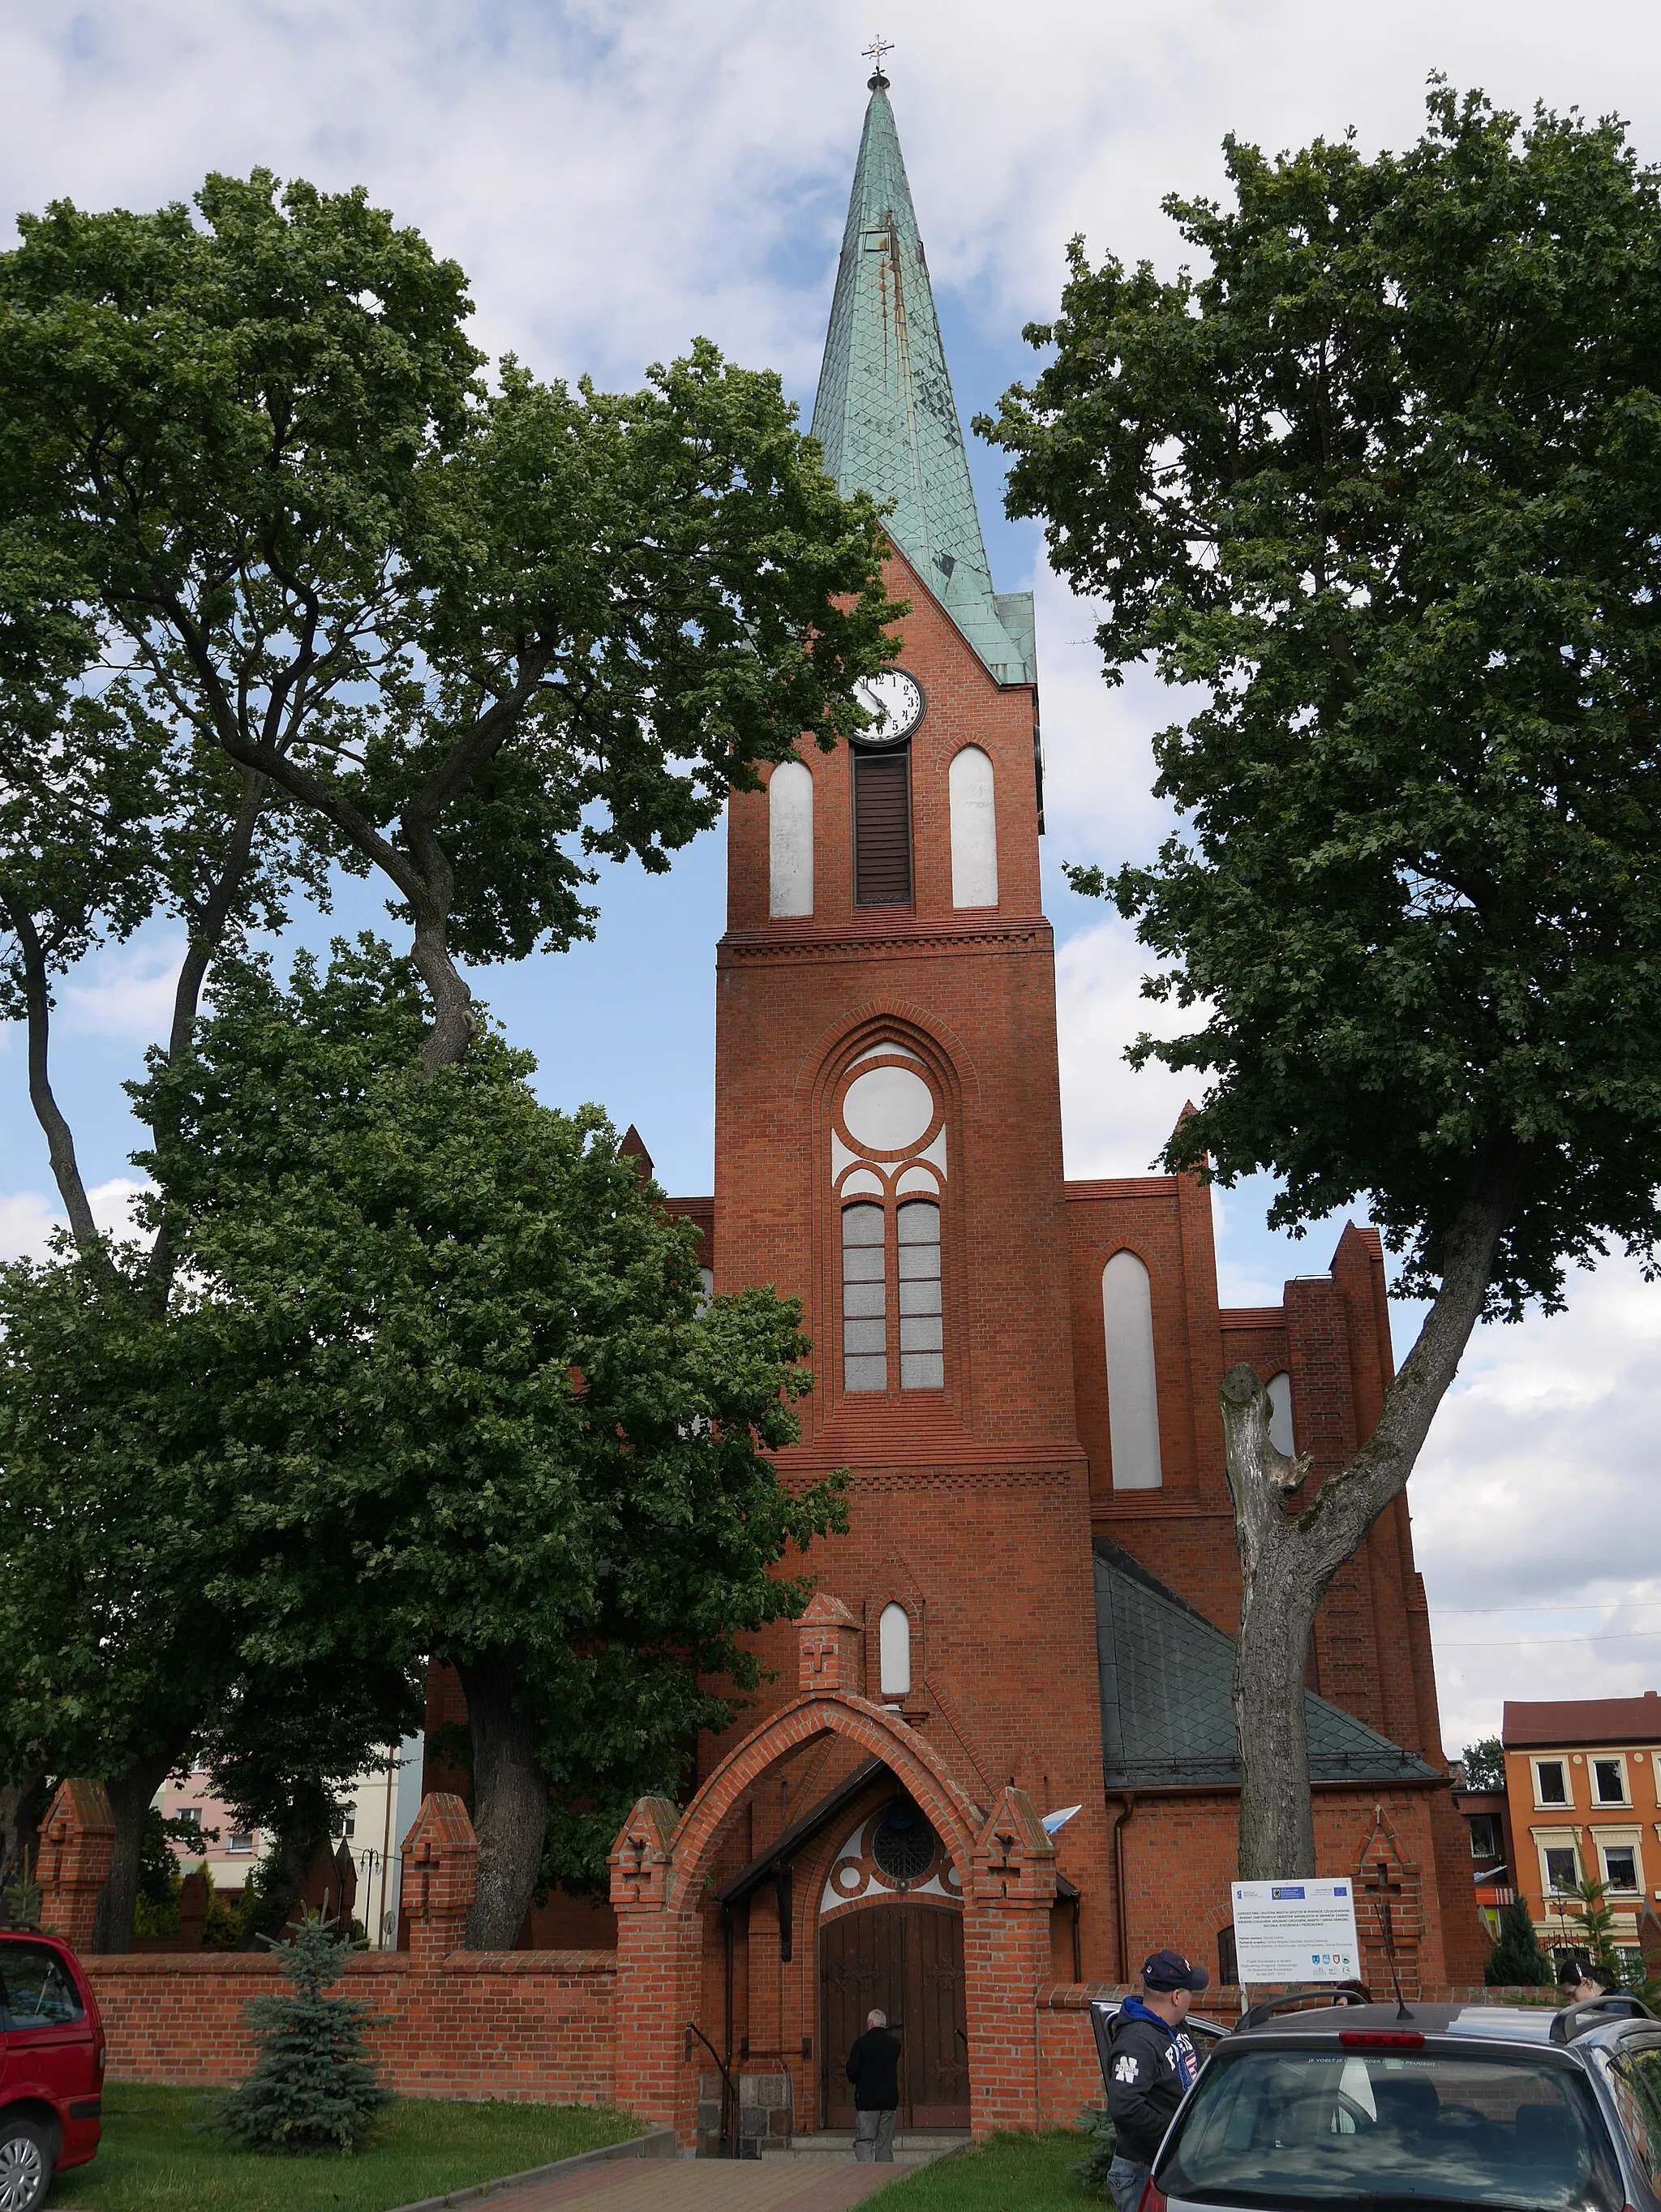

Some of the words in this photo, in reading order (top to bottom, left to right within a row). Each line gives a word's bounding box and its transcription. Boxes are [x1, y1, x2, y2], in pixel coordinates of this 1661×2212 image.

[903, 685, 909, 695] 2
[908, 697, 914, 707] 3
[902, 710, 908, 720] 4
[892, 720, 899, 730] 5
